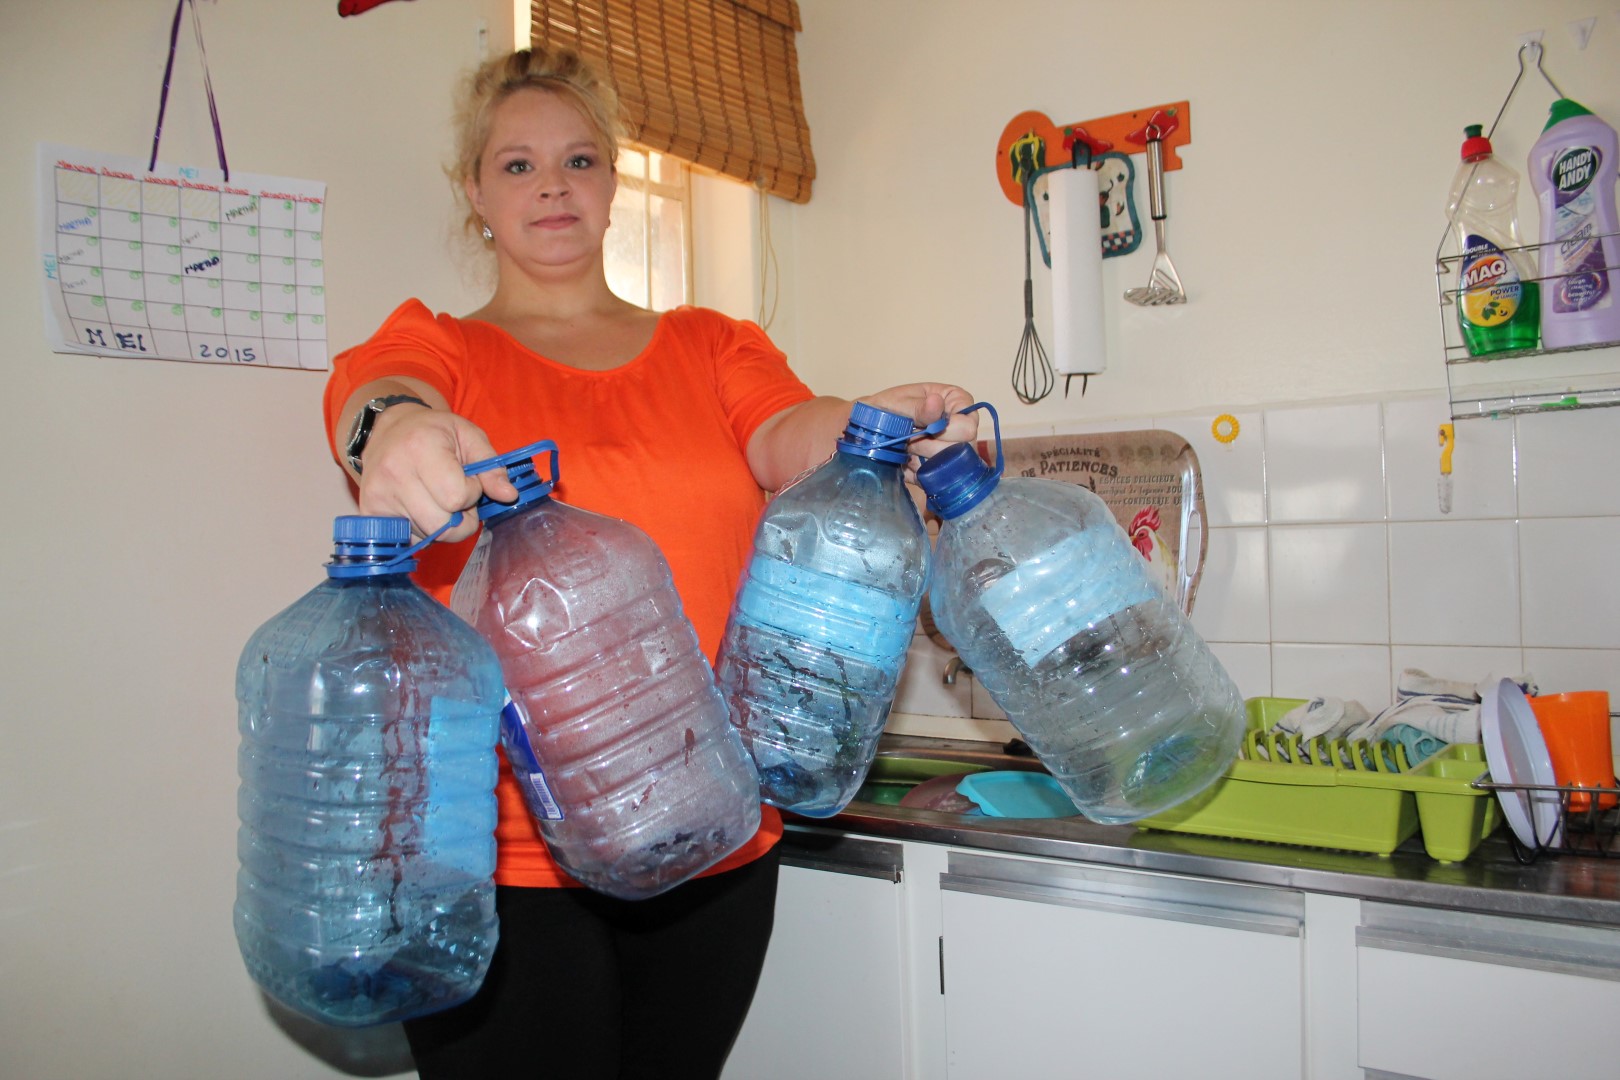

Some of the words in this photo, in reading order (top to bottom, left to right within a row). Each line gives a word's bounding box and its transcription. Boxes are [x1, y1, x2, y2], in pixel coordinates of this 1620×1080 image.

[1558, 147, 1593, 175] HANDY
[1558, 162, 1593, 190] ANDY
[1463, 258, 1508, 288] MAQ
[1490, 285, 1520, 297] POWER
[199, 344, 256, 362] 2015
[1040, 446, 1101, 460] SPÉCIALITÉ
[1021, 467, 1036, 478] DE
[1040, 459, 1118, 478] PATIENCES
